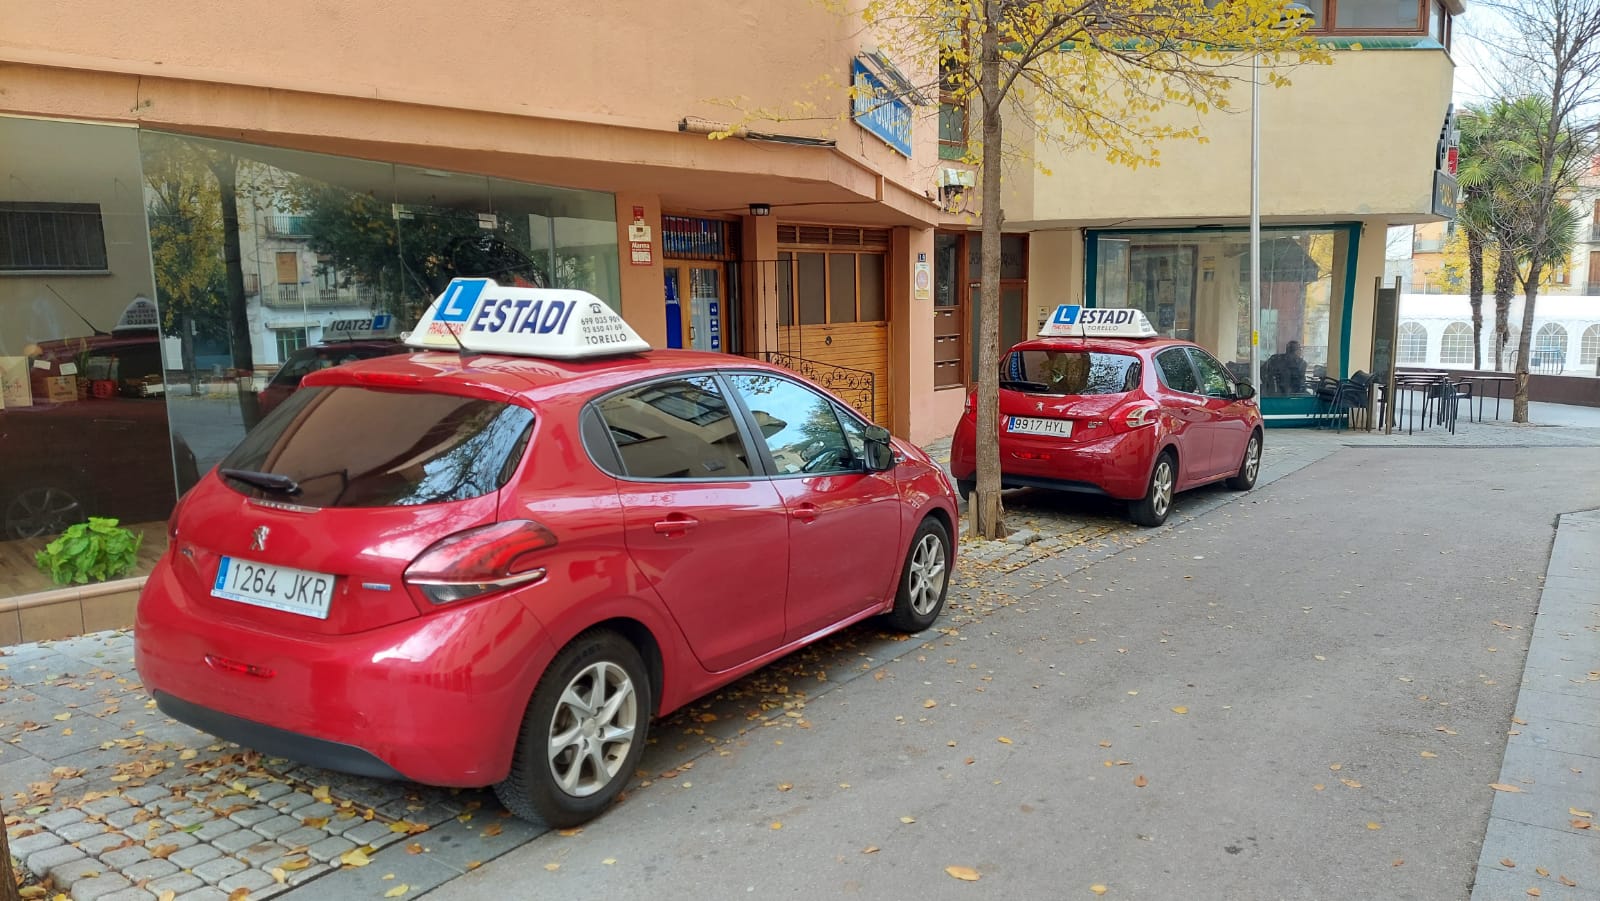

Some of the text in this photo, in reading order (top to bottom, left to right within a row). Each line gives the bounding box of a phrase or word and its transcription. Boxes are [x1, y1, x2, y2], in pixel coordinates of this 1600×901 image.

[443, 285, 463, 315] L
[471, 299, 578, 335] ESTADI
[1059, 308, 1071, 322] L
[1079, 310, 1135, 325] ESTADI
[1015, 419, 1066, 433] 9917 HYL
[232, 563, 327, 606] 1264 JKR
